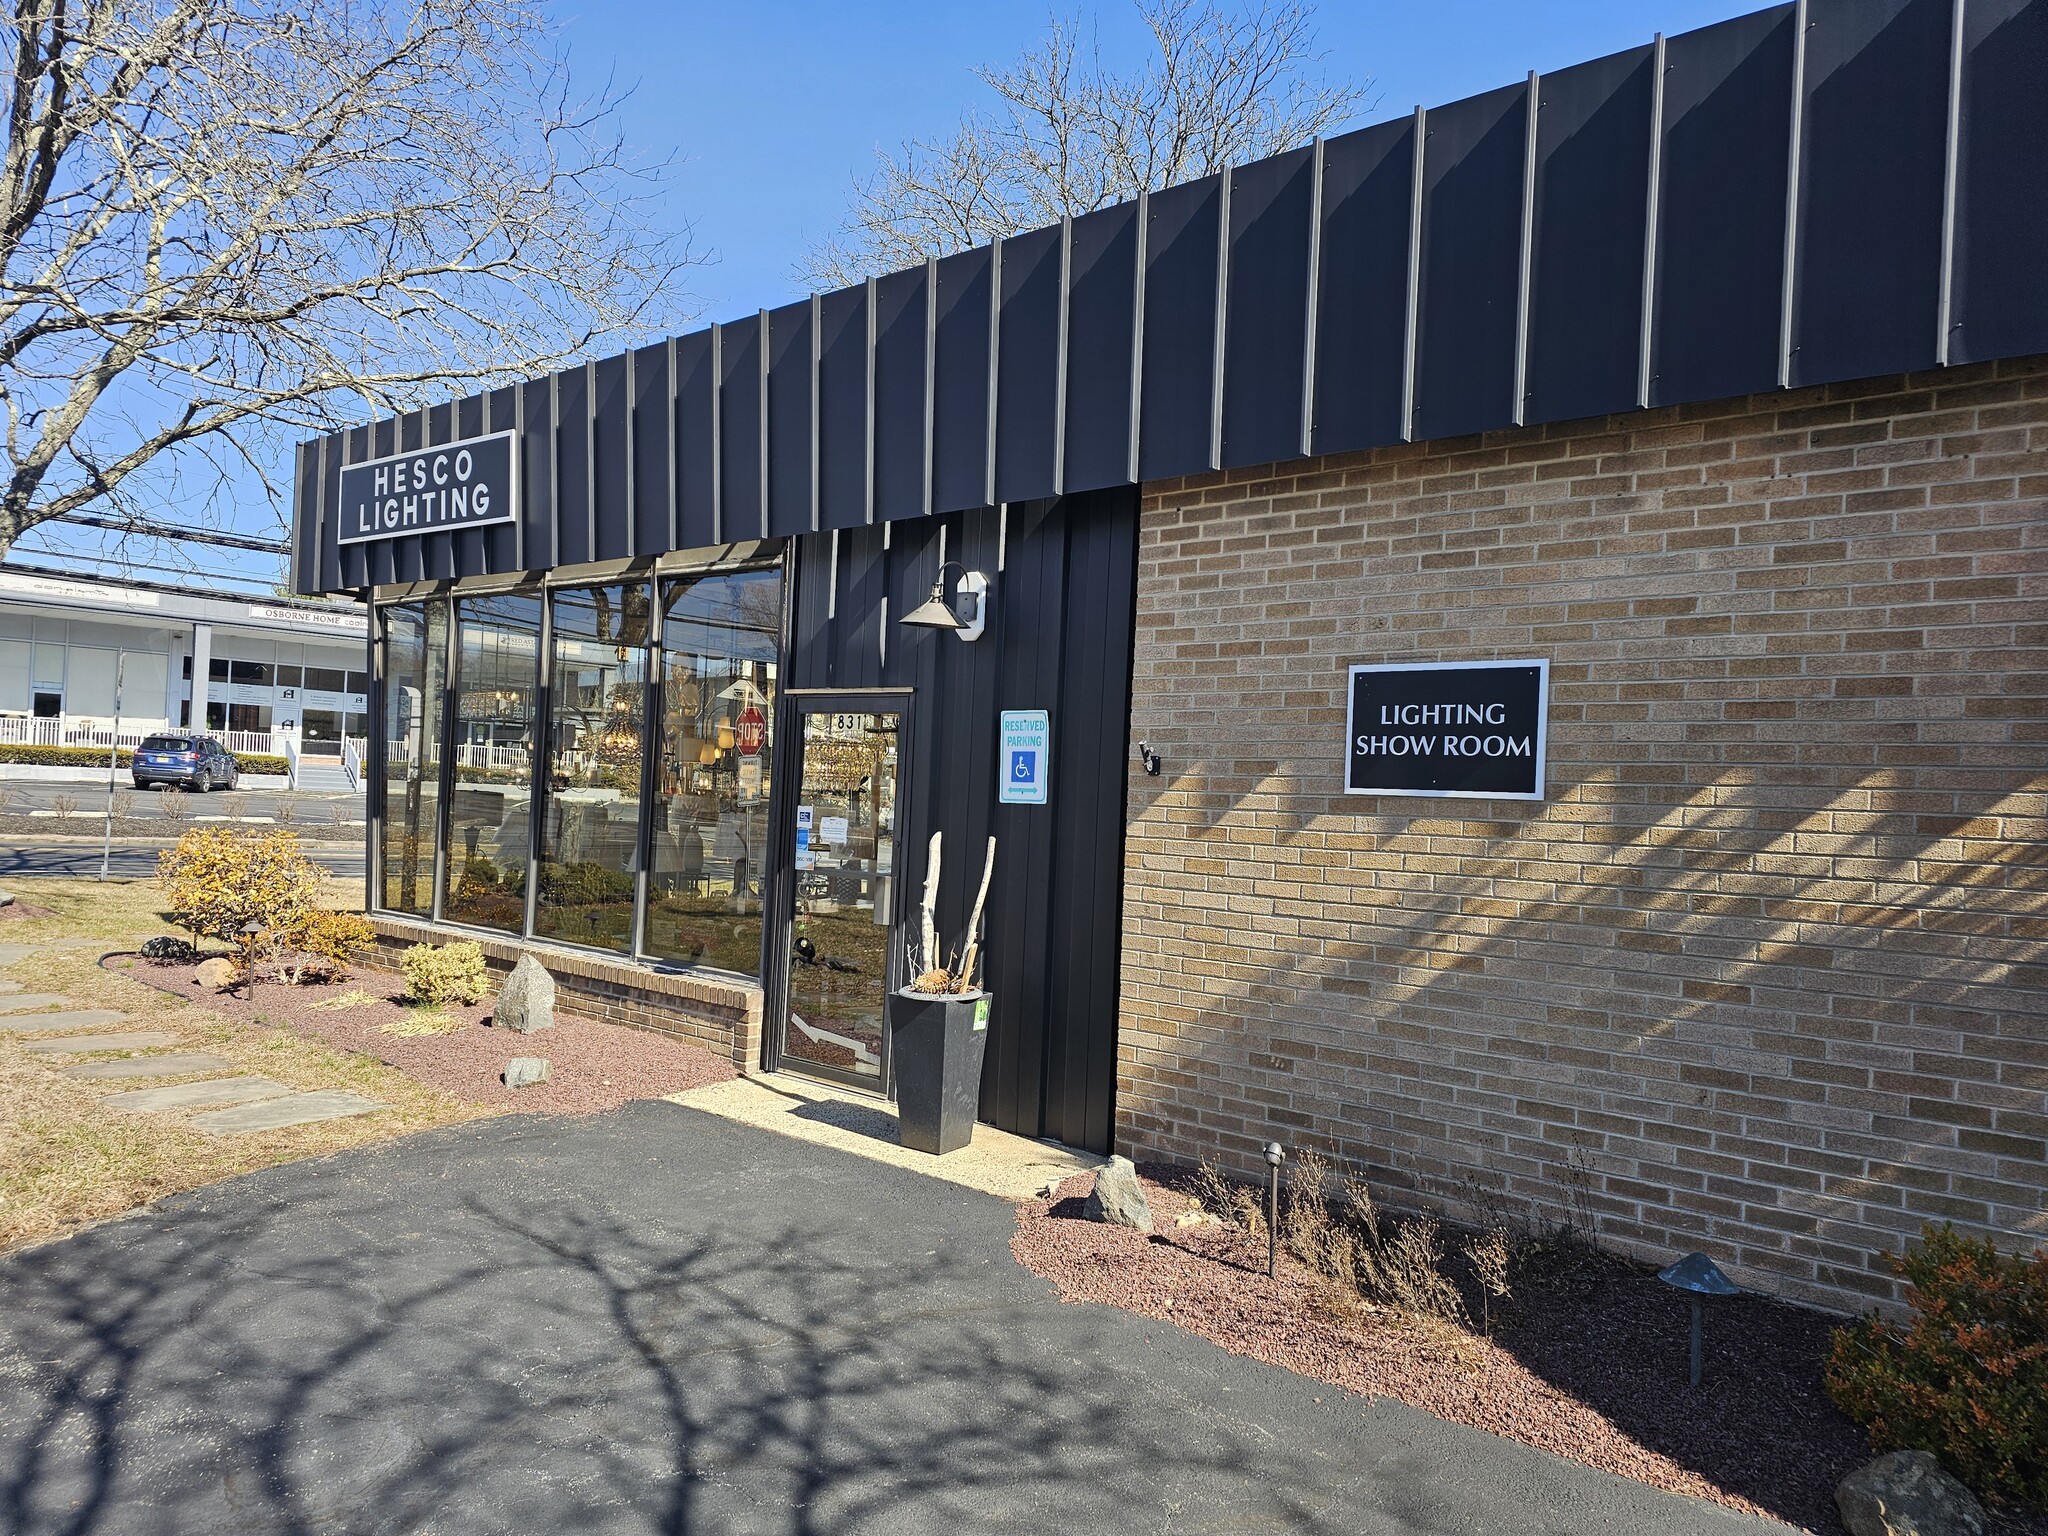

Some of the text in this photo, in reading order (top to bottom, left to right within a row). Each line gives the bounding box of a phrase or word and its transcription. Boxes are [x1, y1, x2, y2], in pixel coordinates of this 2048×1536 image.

[374, 449, 473, 497] HESCO
[359, 482, 490, 532] LIGHTING
[265, 609, 311, 621] OSBORNE
[313, 614, 341, 625] HOME
[837, 714, 862, 730] 831
[1381, 703, 1506, 725] LIGHTING
[1004, 719, 1045, 732] RESERVED
[1007, 735, 1042, 747] PARKING
[1356, 735, 1531, 757] SHOW ROOM
